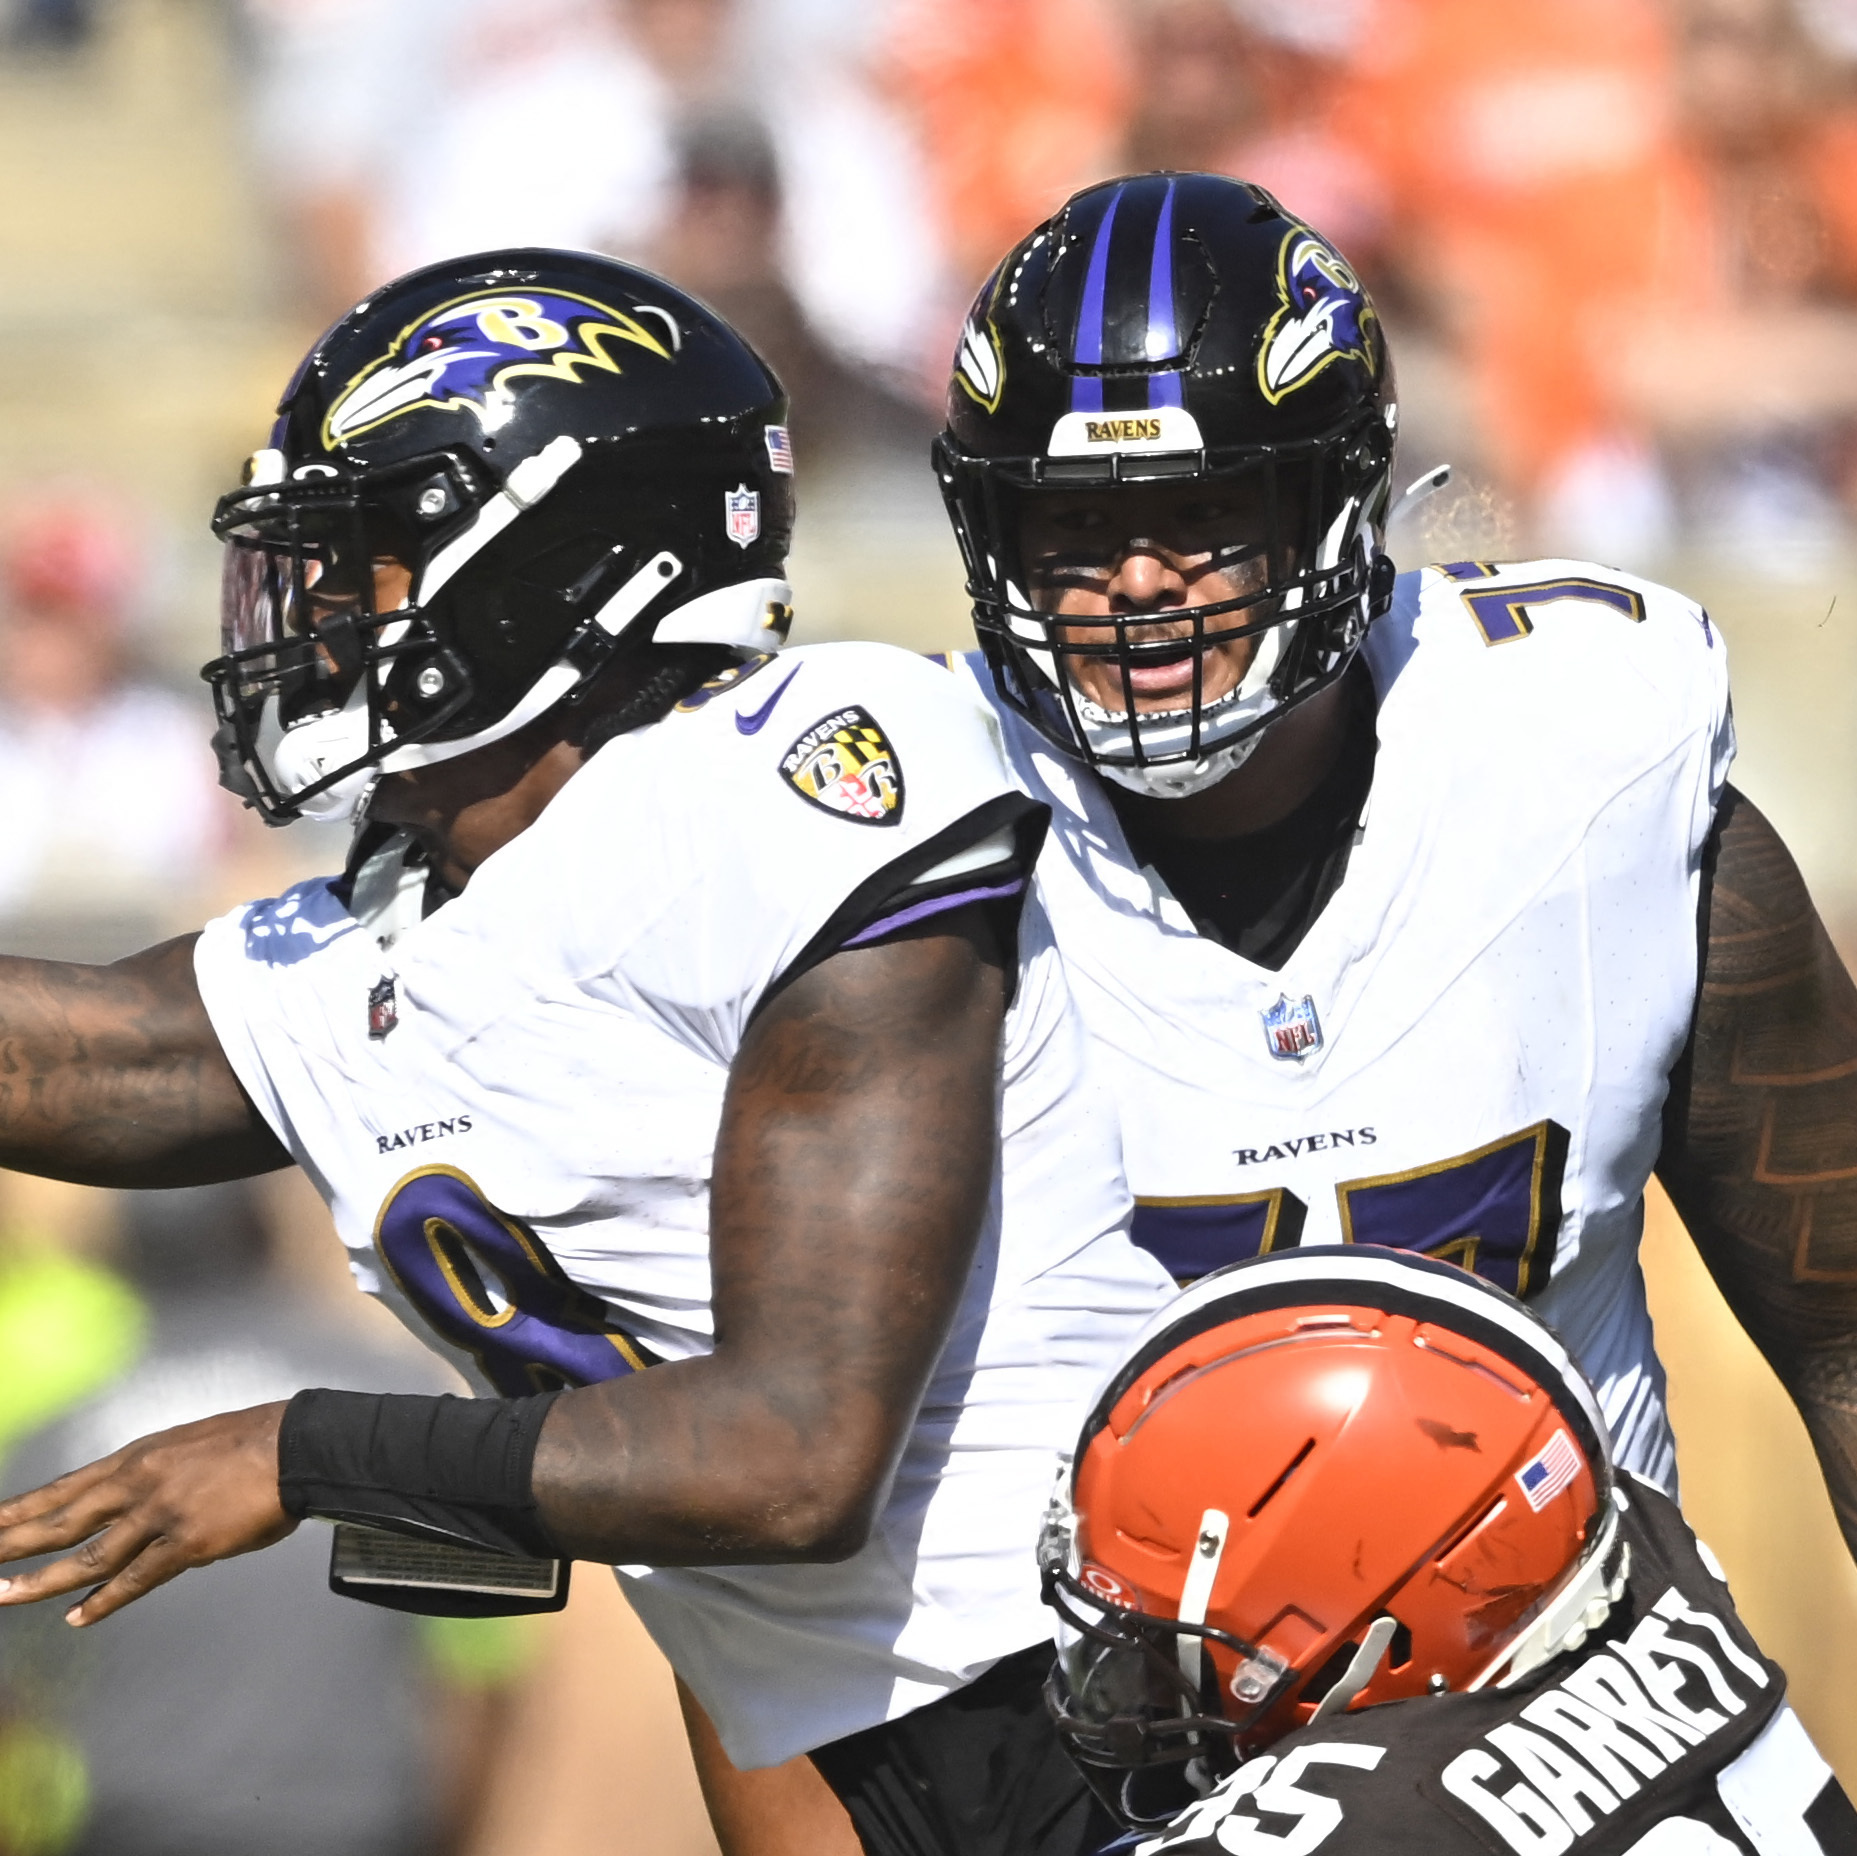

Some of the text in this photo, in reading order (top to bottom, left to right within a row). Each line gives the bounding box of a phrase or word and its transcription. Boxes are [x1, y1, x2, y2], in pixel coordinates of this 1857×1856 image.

[1085, 418, 1161, 443] RAVENS
[782, 709, 860, 773] RAVENS
[1275, 1022, 1316, 1053] NFL
[376, 1115, 473, 1154] RAVENS
[1232, 1127, 1378, 1165] RAVENS
